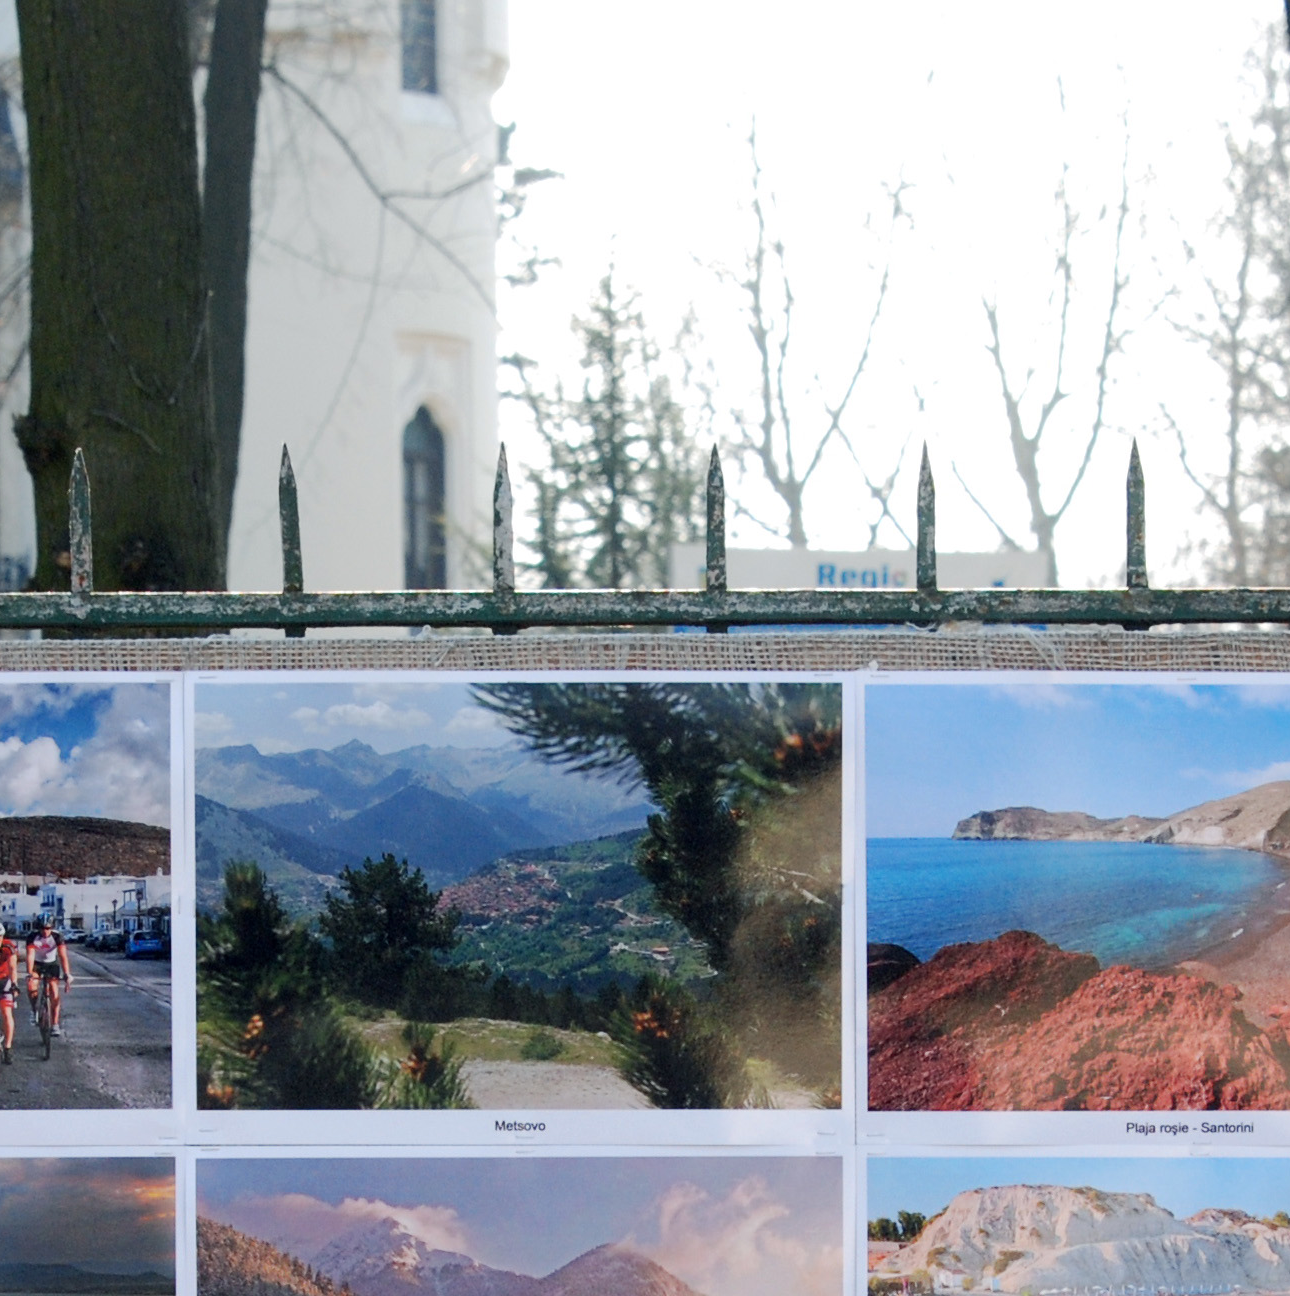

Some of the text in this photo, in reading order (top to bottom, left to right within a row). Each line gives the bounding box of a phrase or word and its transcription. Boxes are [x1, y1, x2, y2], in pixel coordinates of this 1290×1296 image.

[494, 1120, 546, 1131] Metsovo
[1126, 1121, 1156, 1136] Plaja
[1201, 1121, 1254, 1134] Santorini
